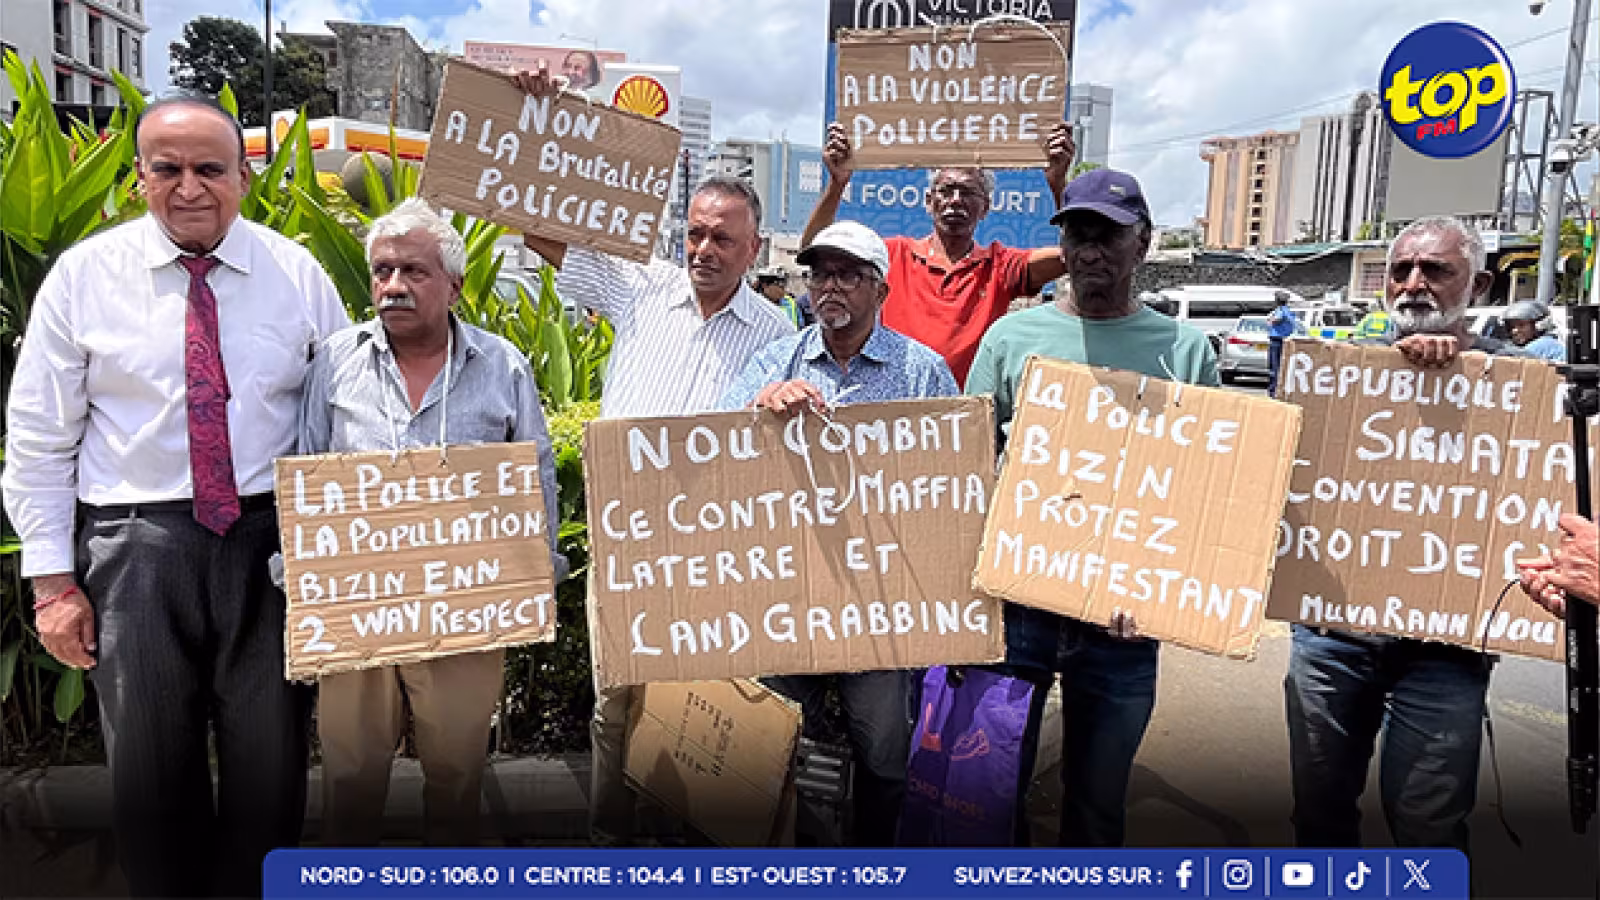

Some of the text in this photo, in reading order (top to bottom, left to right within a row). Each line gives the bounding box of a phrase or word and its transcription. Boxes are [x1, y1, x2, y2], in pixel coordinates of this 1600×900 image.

[908, 42, 977, 71] NON
[844, 74, 1057, 106] A LA VIOLENCE
[445, 111, 467, 143] A
[477, 119, 519, 165] LA
[518, 96, 601, 141] NON
[853, 114, 1040, 150] POLICIERE
[862, 184, 931, 208] FOO
[1284, 353, 1524, 413] REPUBLIQUE
[627, 412, 970, 473] NOU COMBAT
[294, 462, 538, 516] LA POLICE ET
[601, 469, 986, 539] CE CONTRE MAFFIA
[295, 523, 339, 560] LA
[1014, 480, 1179, 554] PROTEZ
[606, 537, 899, 590] LATERRE ET
[993, 530, 1262, 628] MANIFESTANT
[1408, 532, 1482, 578] DE
[300, 558, 500, 605] BIZIN ENN
[300, 593, 552, 652] 2 WAY RESPECT
[763, 601, 989, 643] GRABBING
